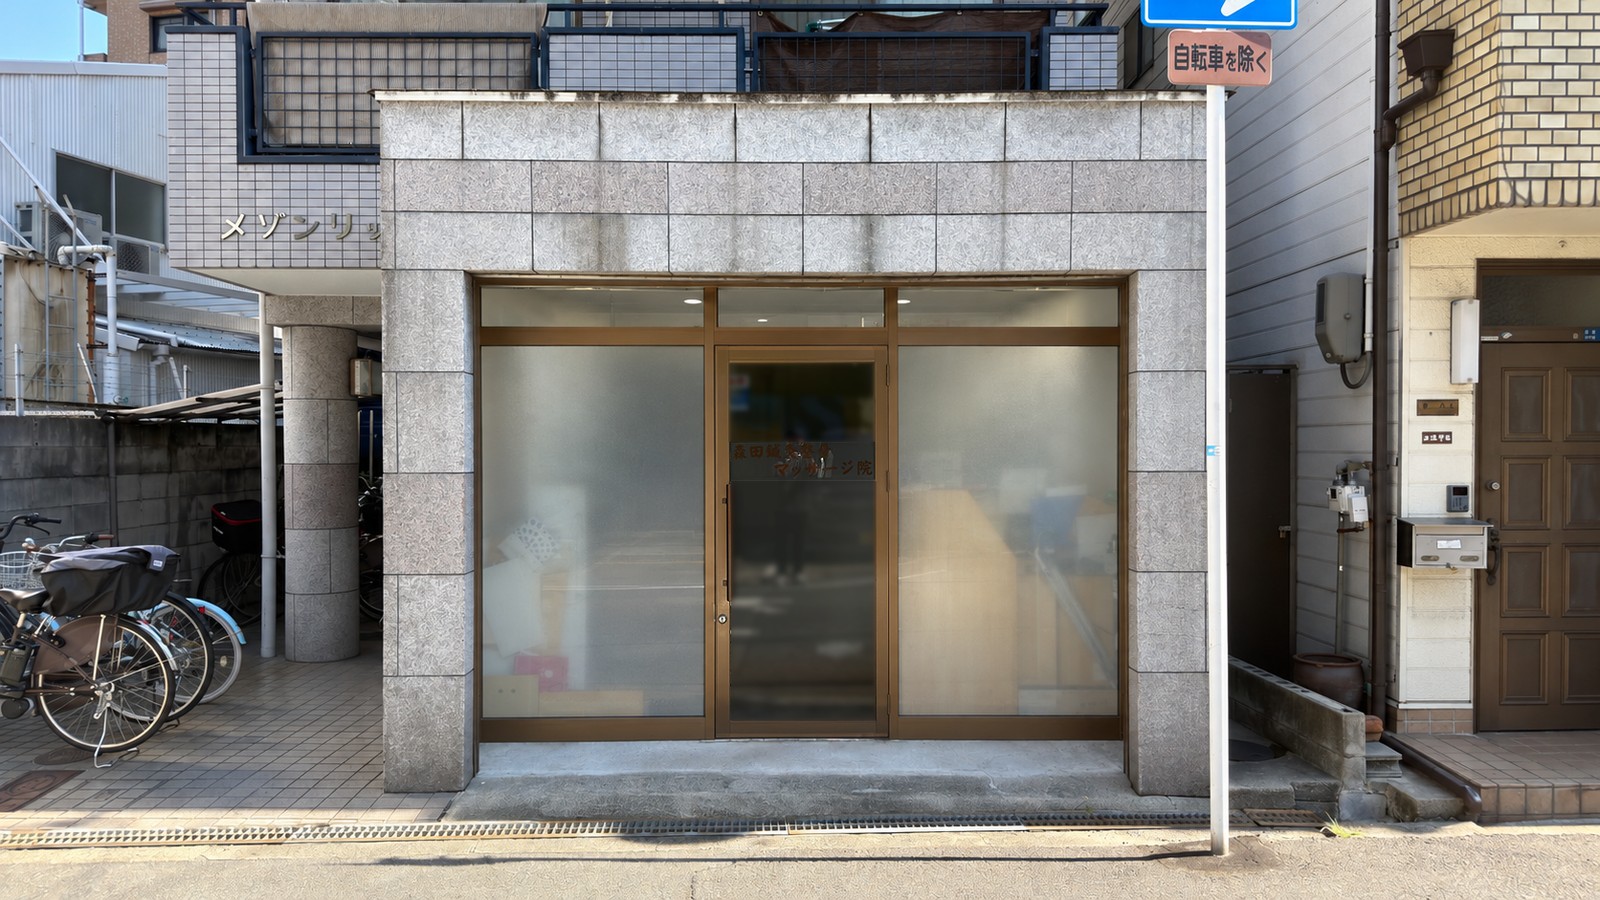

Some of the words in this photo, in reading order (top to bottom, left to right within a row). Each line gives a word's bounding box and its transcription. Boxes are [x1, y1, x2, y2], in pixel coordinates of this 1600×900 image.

[1174, 43, 1267, 73] 自転車を除く
